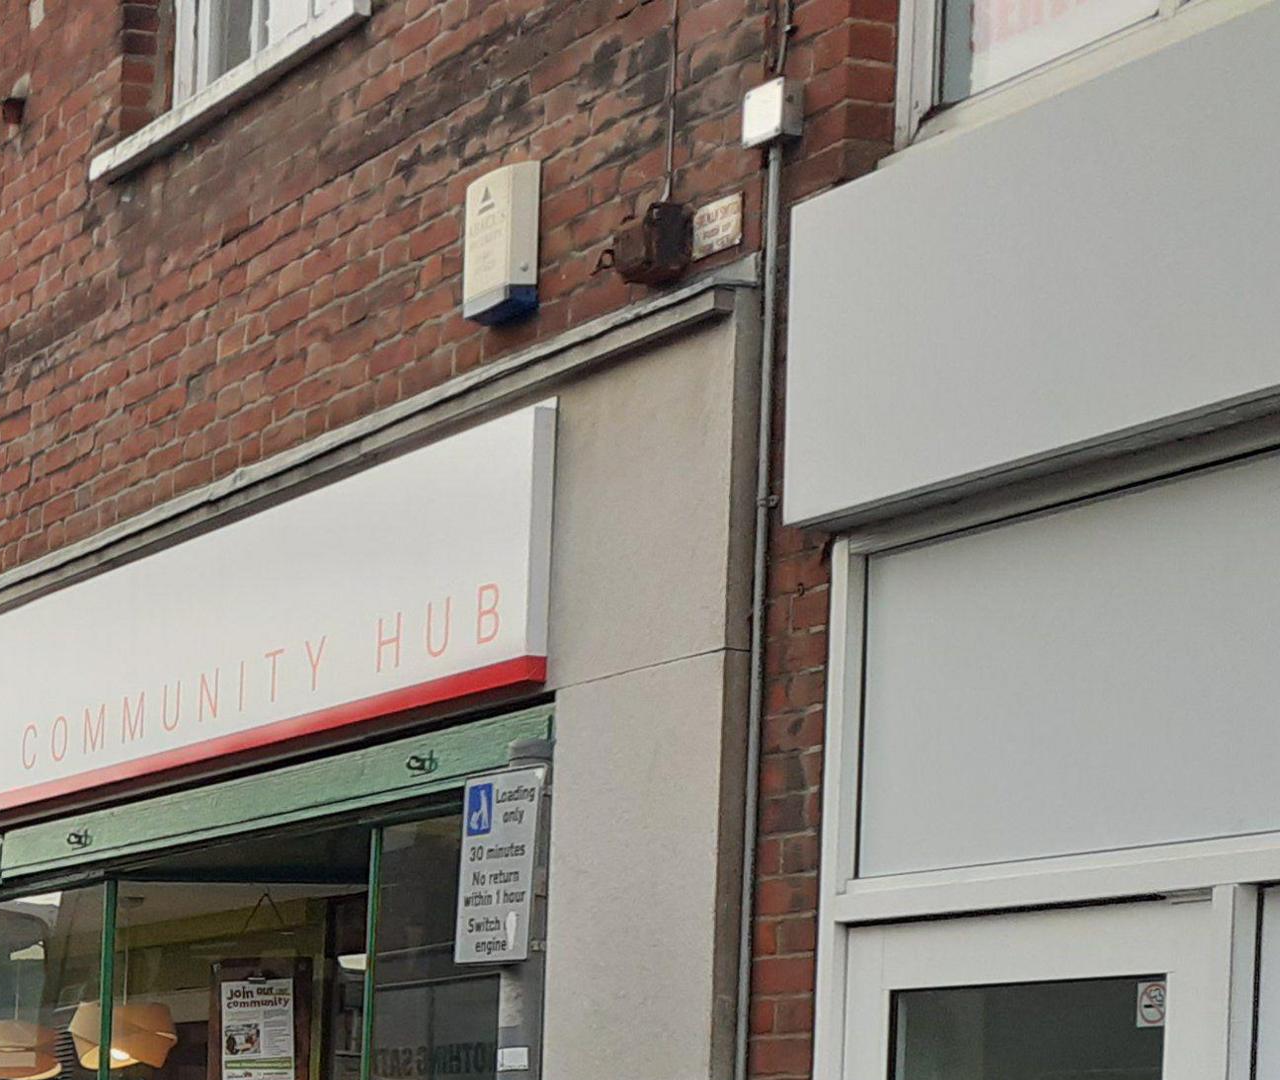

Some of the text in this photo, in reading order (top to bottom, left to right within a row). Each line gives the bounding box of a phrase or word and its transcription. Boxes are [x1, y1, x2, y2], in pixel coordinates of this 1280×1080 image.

[22, 635, 326, 770] COMMUNITY
[376, 583, 500, 672] HUB
[496, 785, 535, 804] Loading
[503, 807, 524, 823] only
[469, 842, 525, 862] 30 minutes
[472, 870, 519, 886] No return
[464, 889, 526, 907] within 1 hour
[467, 914, 500, 933] Switch
[475, 935, 507, 955] engine
[226, 998, 290, 1009] community
